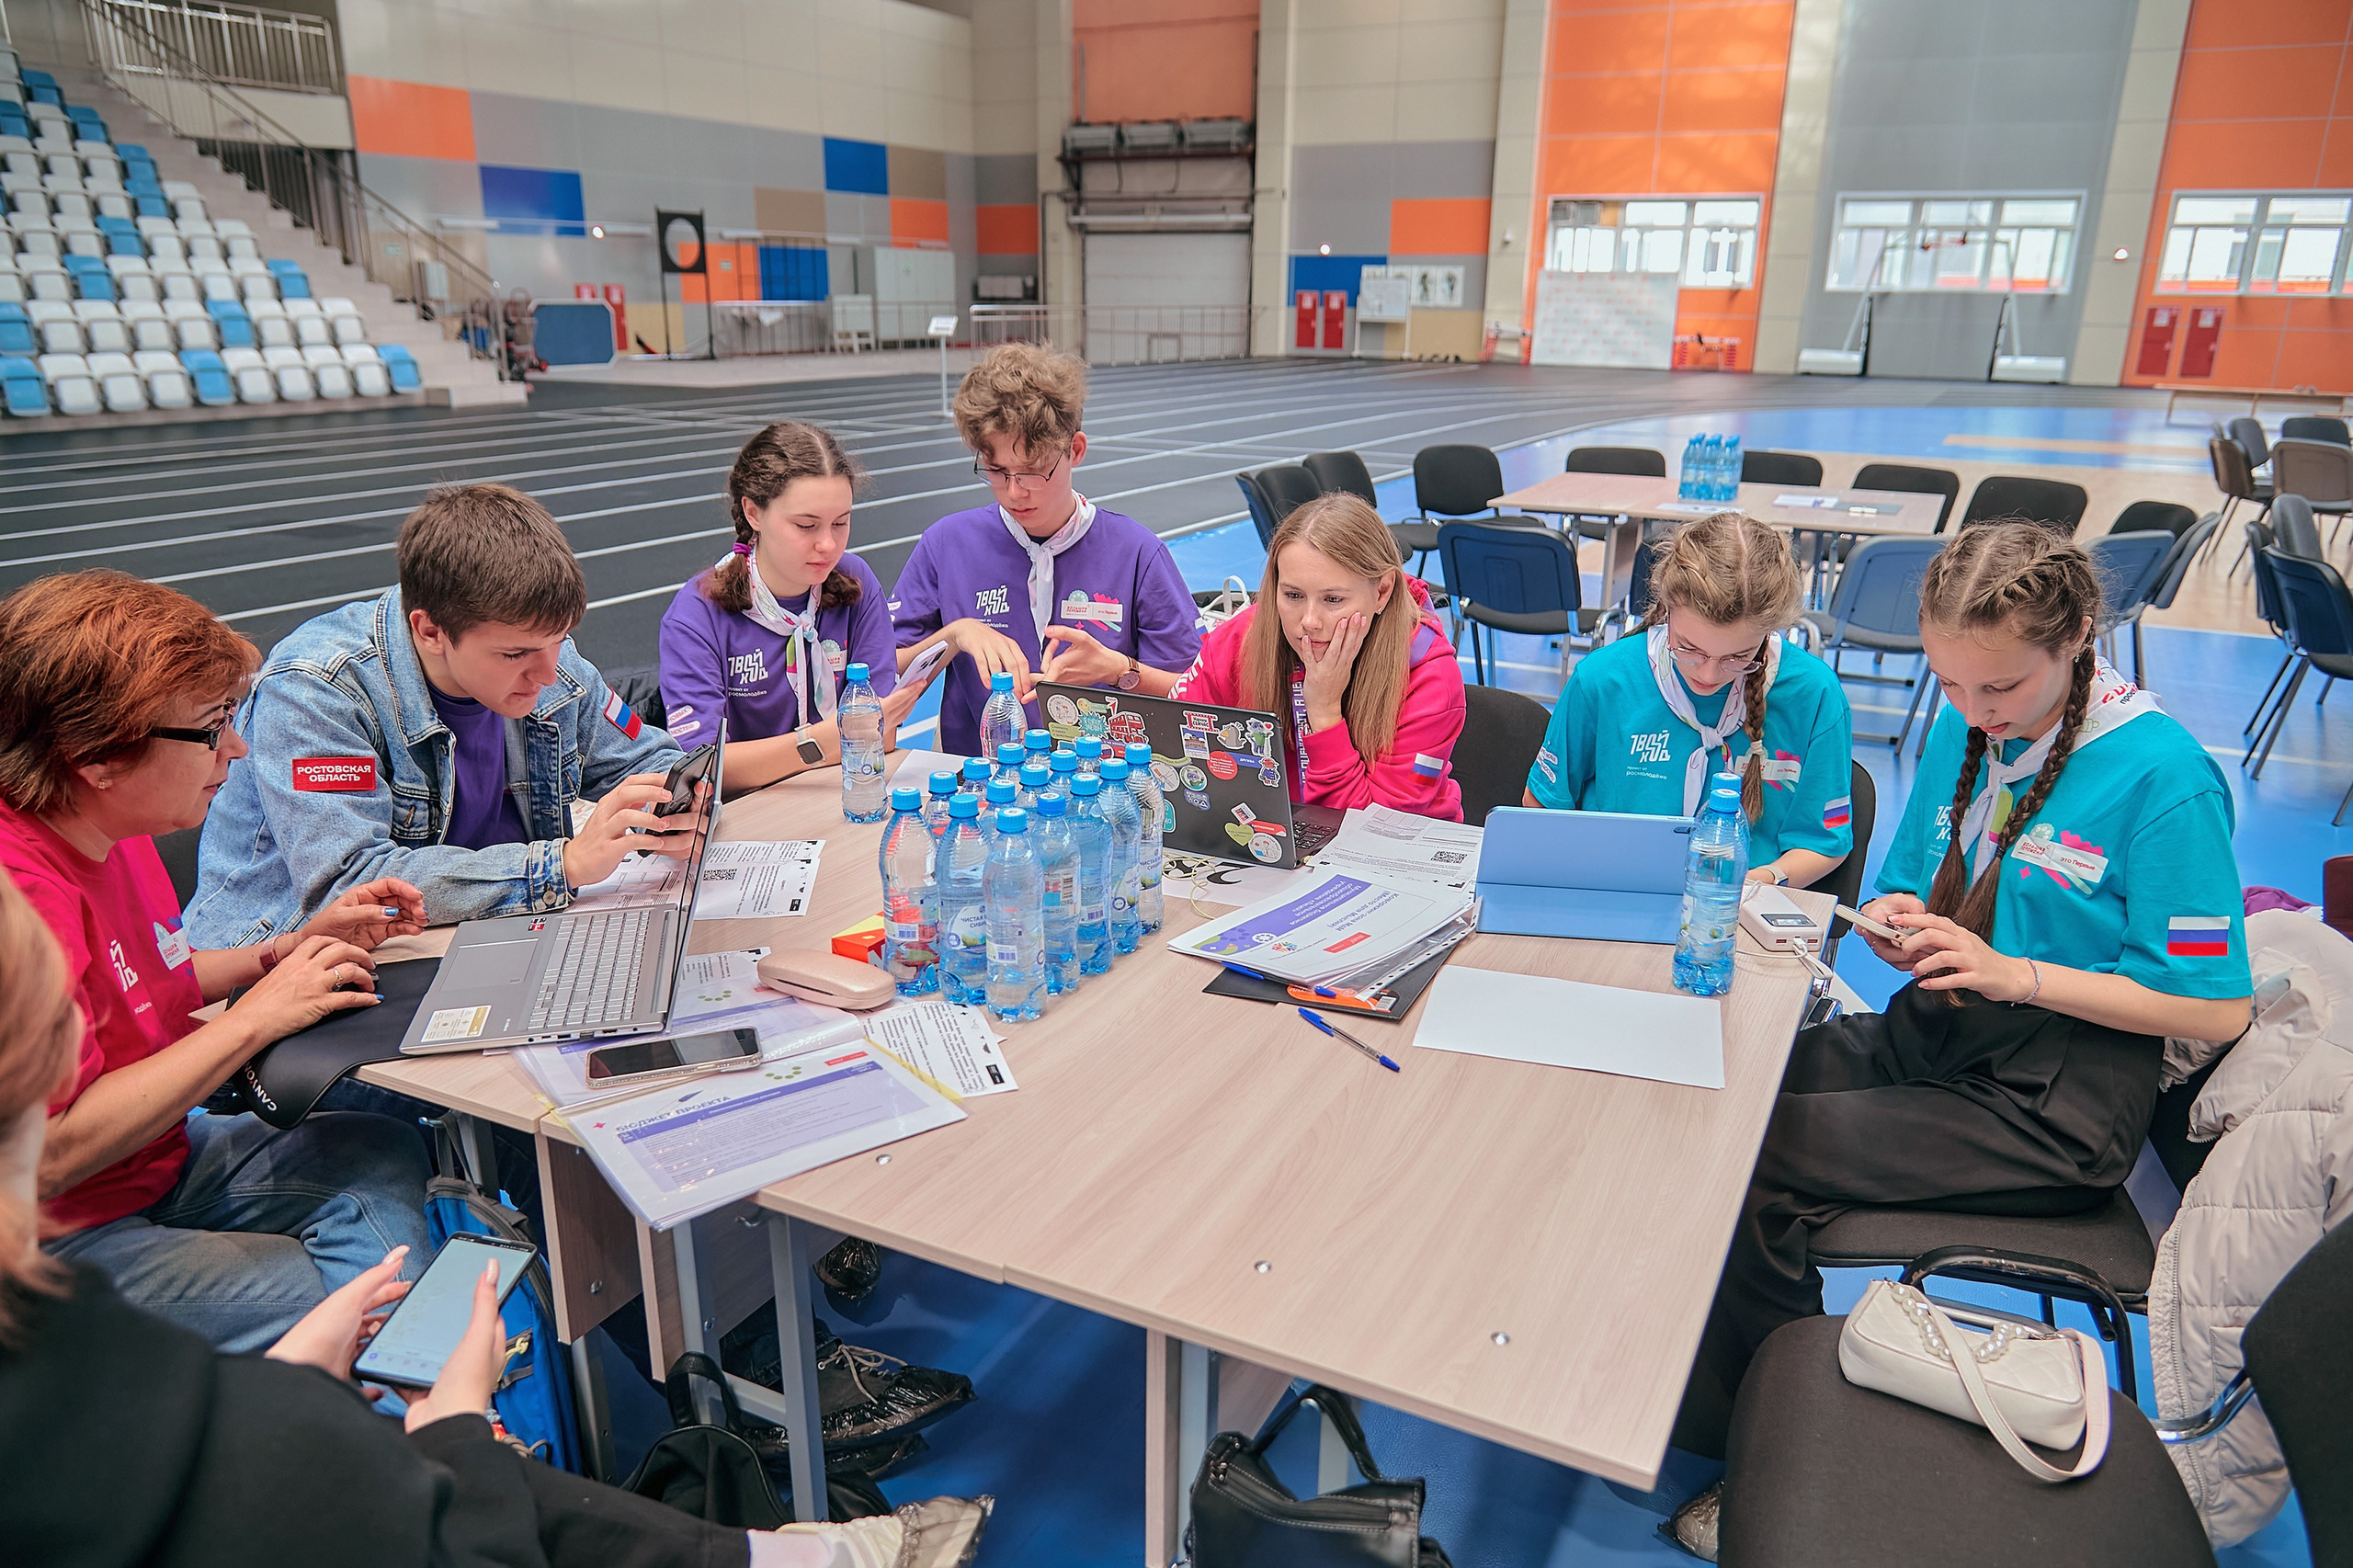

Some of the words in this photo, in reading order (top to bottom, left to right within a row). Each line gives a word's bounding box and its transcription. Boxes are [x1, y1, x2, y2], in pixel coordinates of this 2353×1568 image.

[297, 765, 371, 775] РОСТОВСКАЯ
[309, 773, 361, 782] ОБЛАСТЬ
[2073, 859, 2096, 870] Первые
[244, 1061, 278, 1111] CANYON
[676, 1096, 732, 1115] ПРОЕКТА
